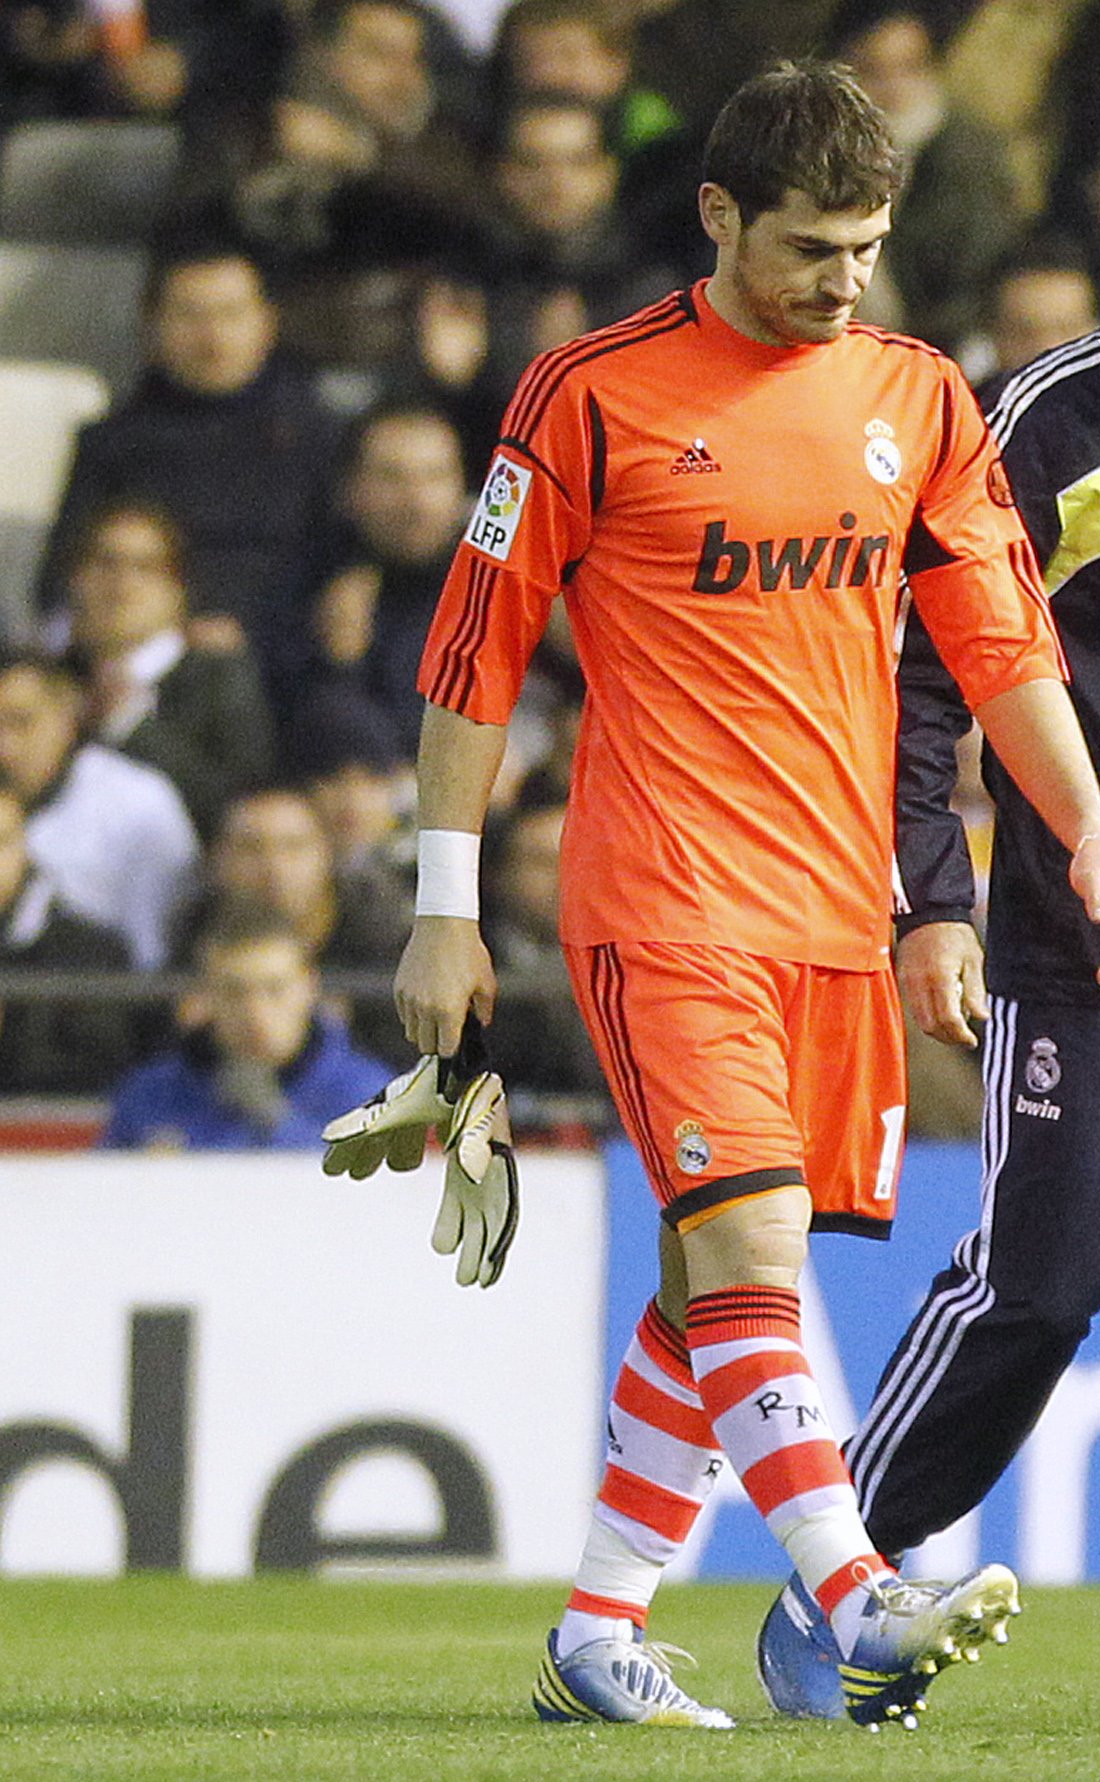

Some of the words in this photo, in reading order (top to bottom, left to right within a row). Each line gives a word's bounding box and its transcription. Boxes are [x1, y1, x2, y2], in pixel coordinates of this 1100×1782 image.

[470, 515, 507, 552] LFP
[692, 512, 889, 595] bwin
[1016, 1094, 1062, 1121] bwin
[874, 1105, 906, 1200] 1
